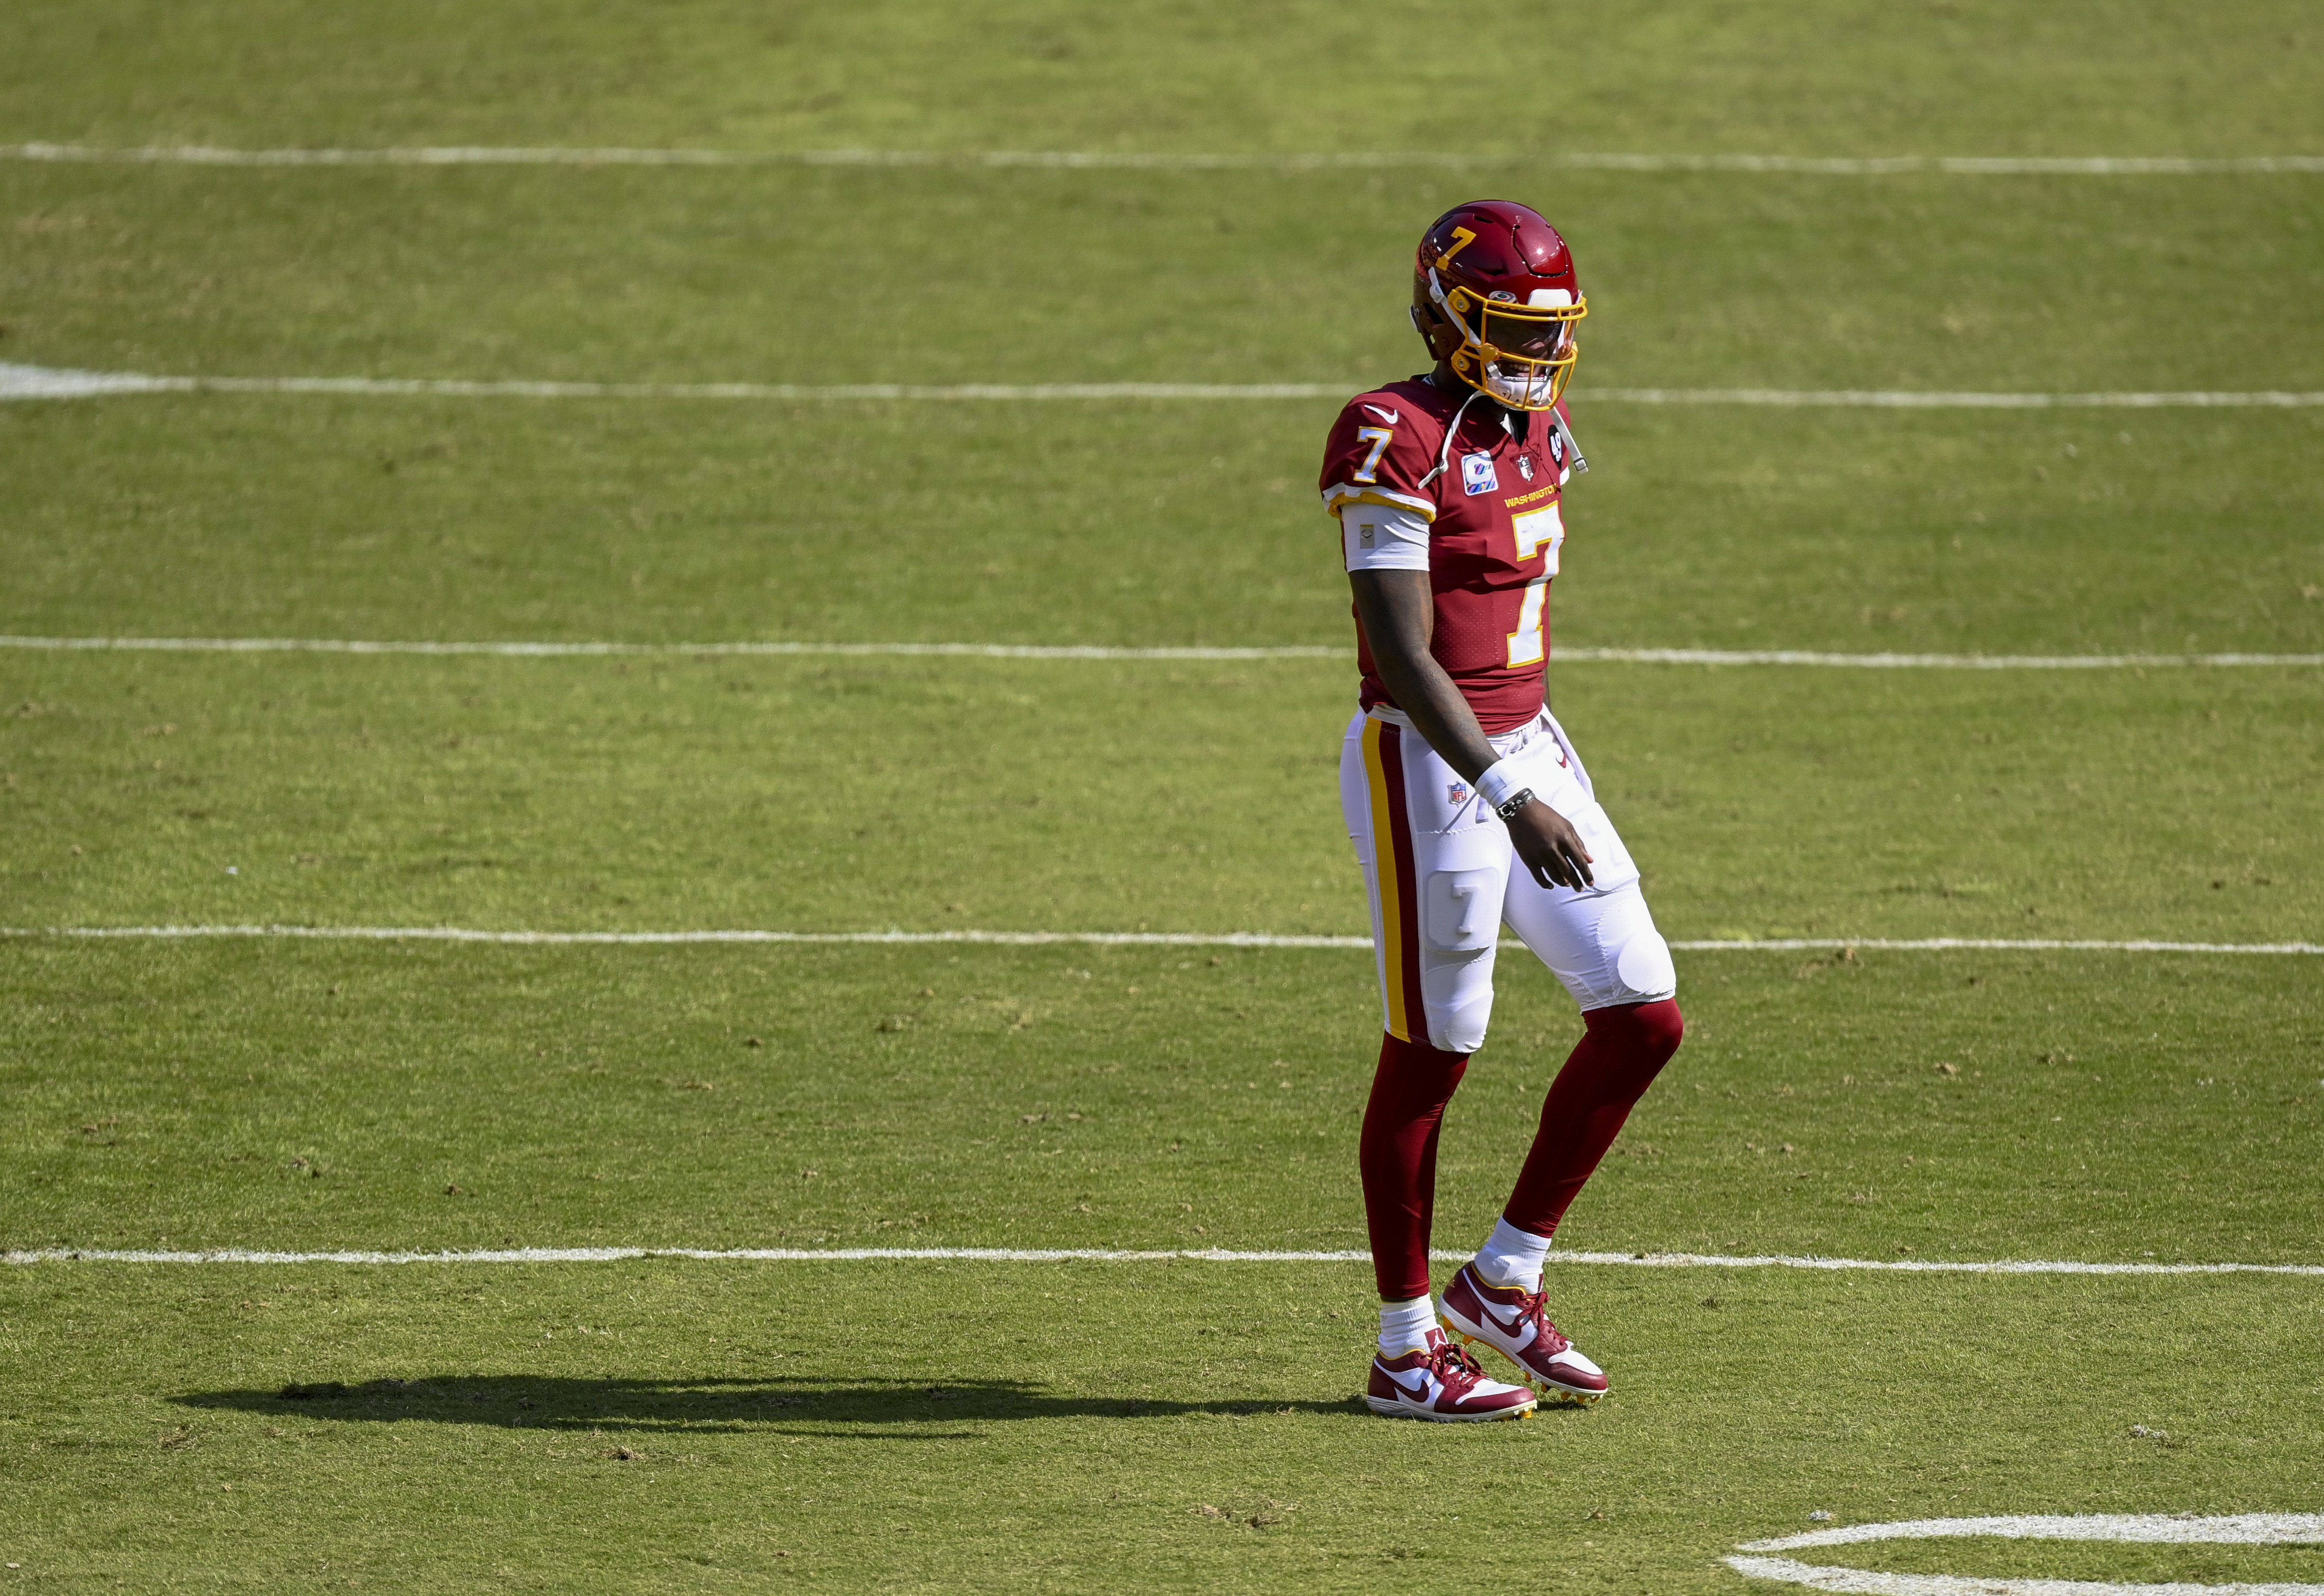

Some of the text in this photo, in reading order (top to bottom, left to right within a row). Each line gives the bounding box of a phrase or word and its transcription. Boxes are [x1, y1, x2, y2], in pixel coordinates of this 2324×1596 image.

[1435, 226, 1476, 271] 7
[1353, 426, 1393, 483] 7
[1550, 432, 1562, 462] 49
[1507, 500, 1565, 668] 7
[1453, 791, 1465, 801] NFL
[1452, 885, 1479, 935] 7
